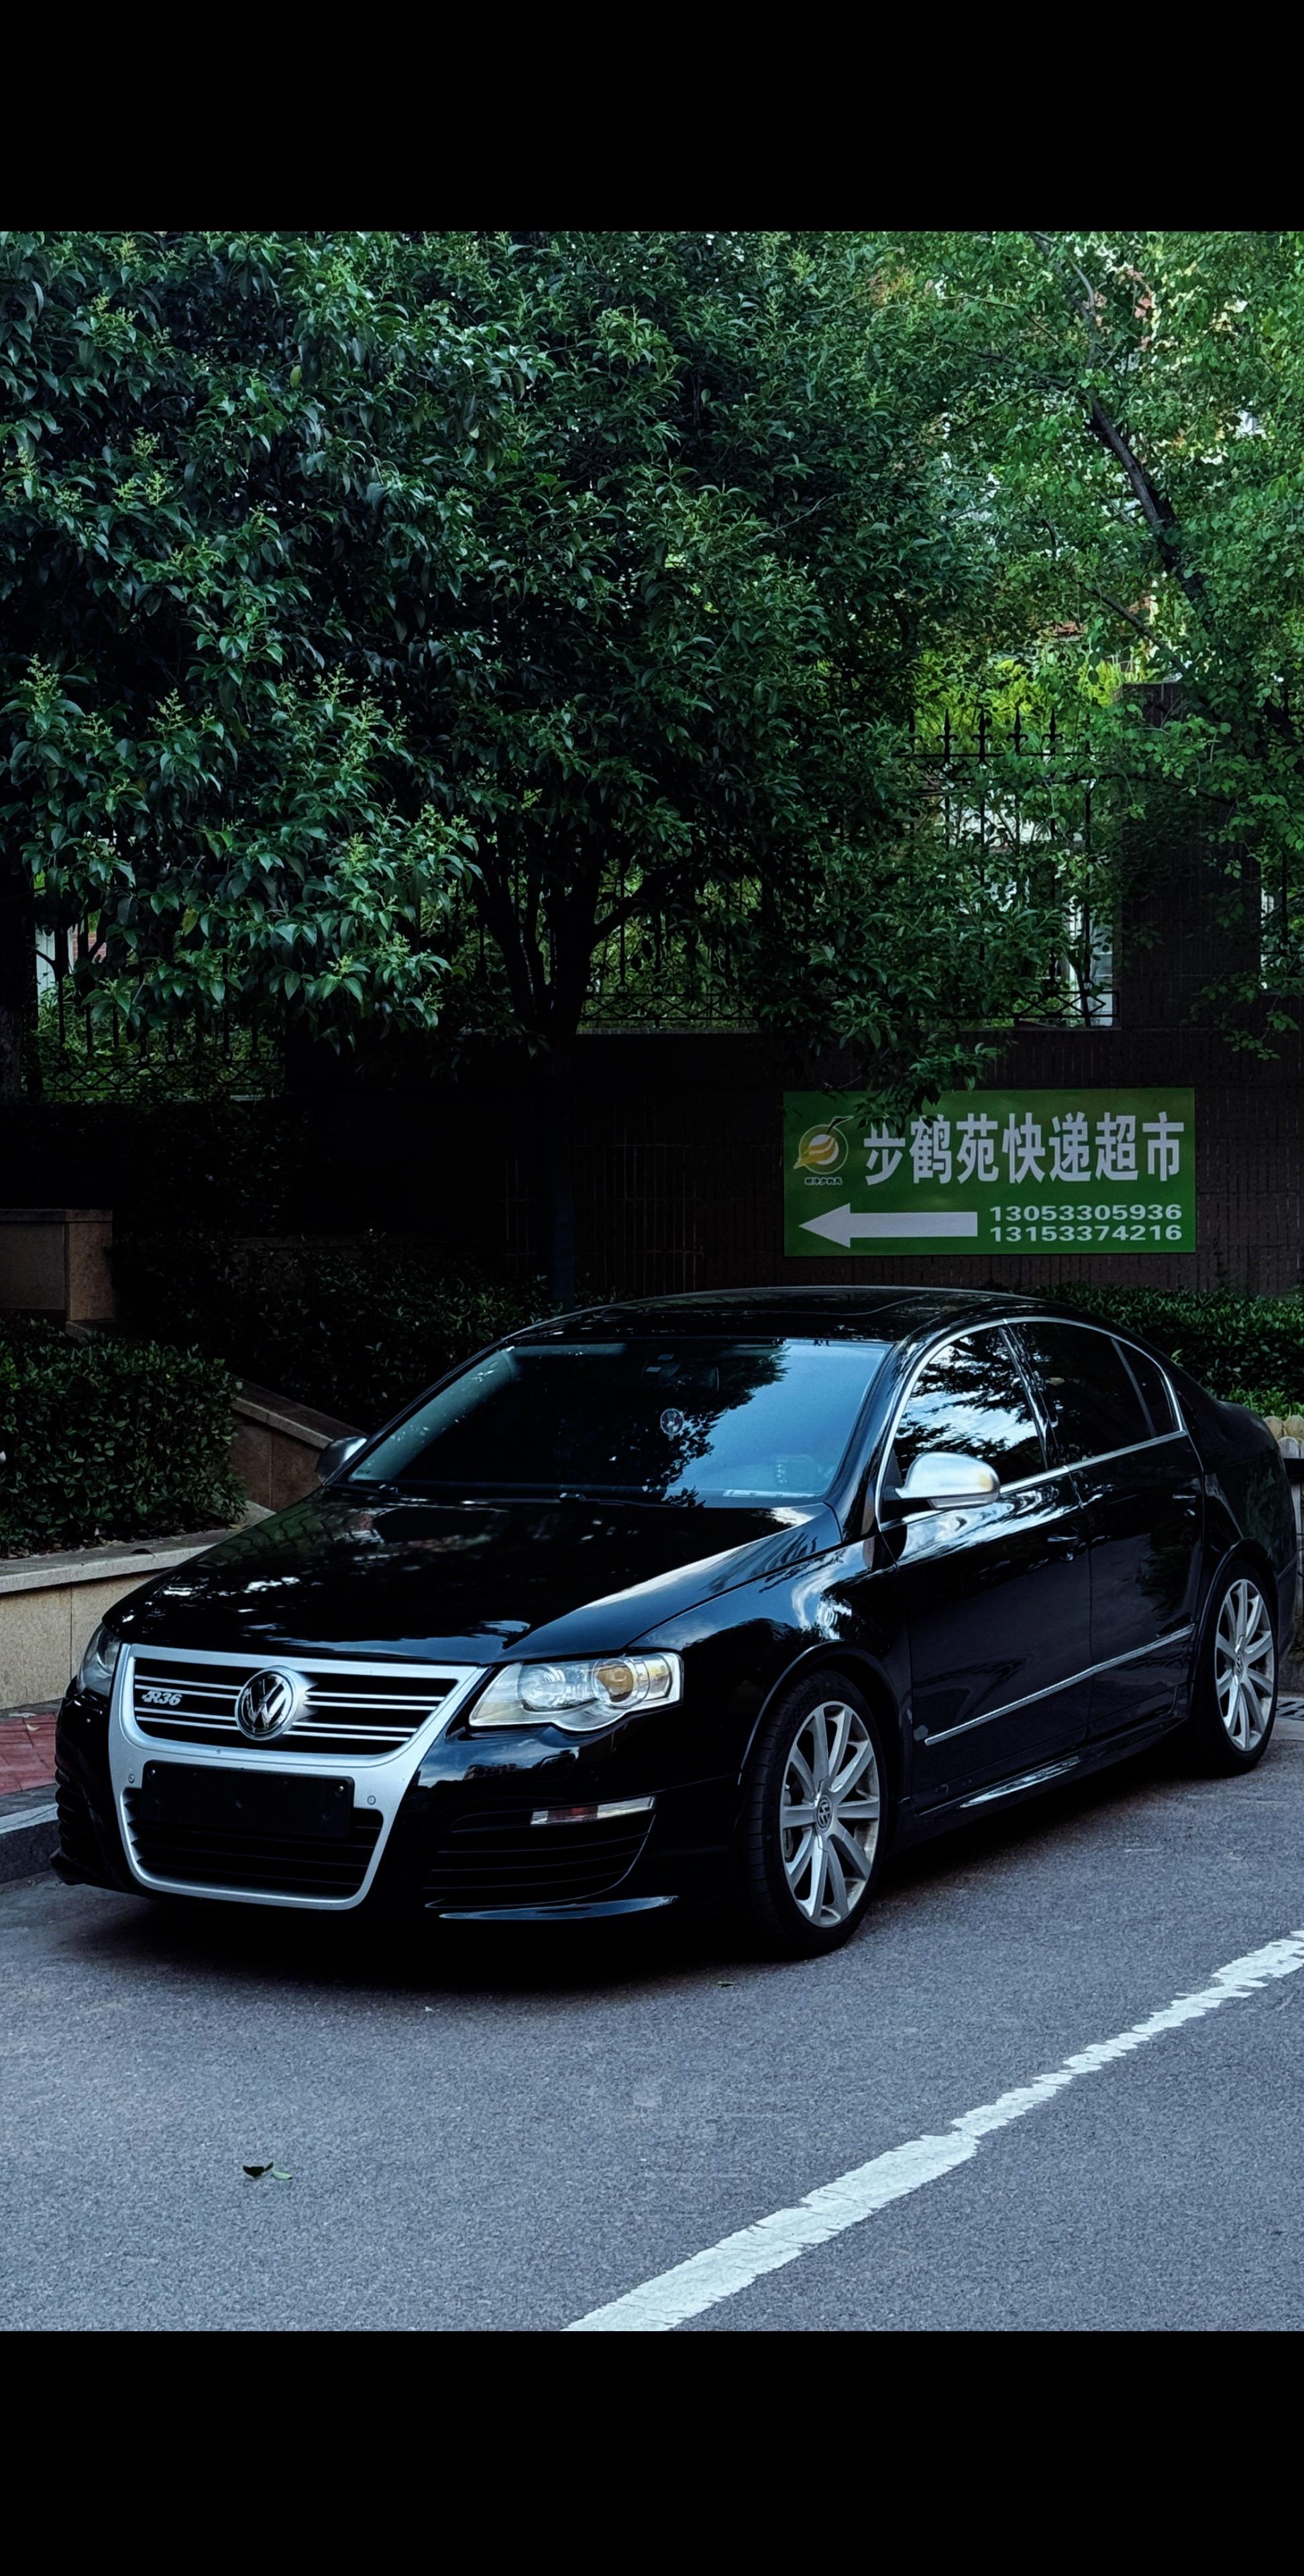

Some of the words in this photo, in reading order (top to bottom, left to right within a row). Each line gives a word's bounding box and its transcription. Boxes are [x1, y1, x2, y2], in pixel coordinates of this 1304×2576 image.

[864, 1112, 1184, 1185] 步鹤苑快递超市
[989, 1204, 1182, 1221] 13053305936
[990, 1225, 1182, 1242] 13153374216
[143, 1690, 182, 1706] R36
